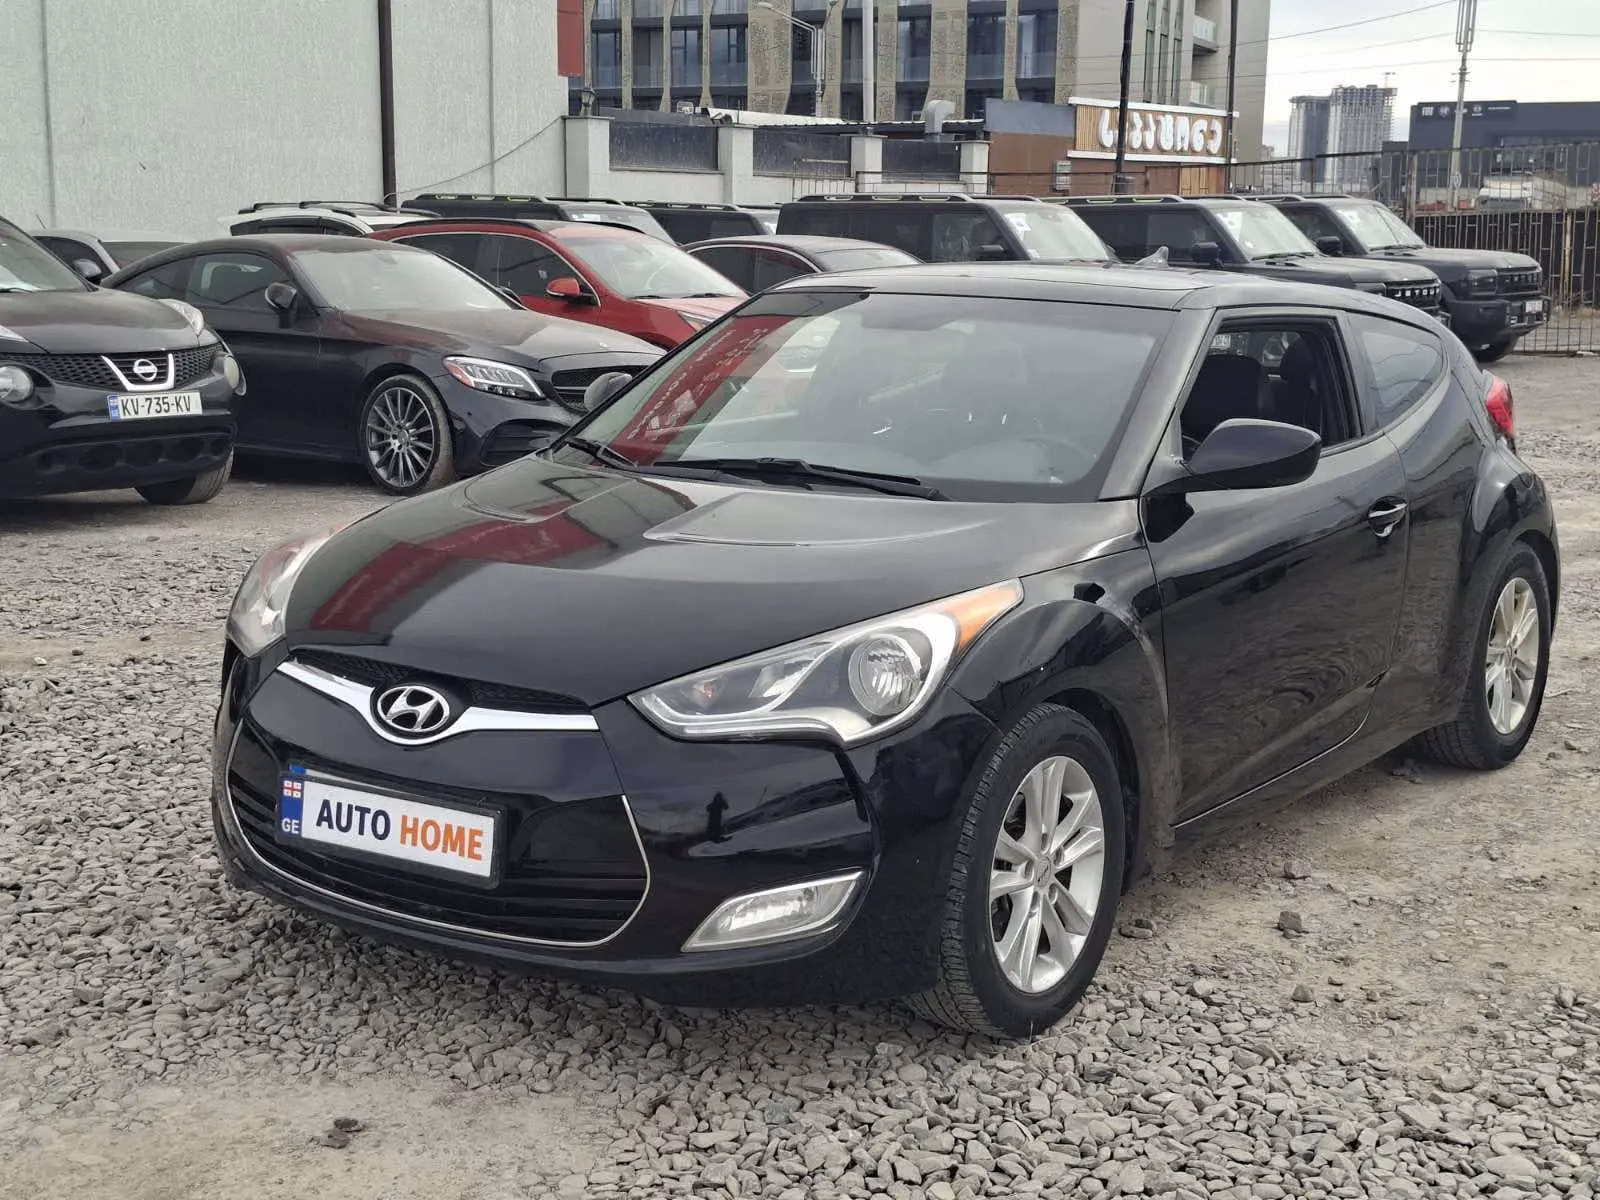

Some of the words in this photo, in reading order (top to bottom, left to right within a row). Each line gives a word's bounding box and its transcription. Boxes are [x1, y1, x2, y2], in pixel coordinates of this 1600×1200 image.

[121, 395, 191, 417] KV-735-KV
[281, 817, 300, 834] GE
[316, 799, 391, 841] AUTO
[400, 815, 484, 861] HOME
